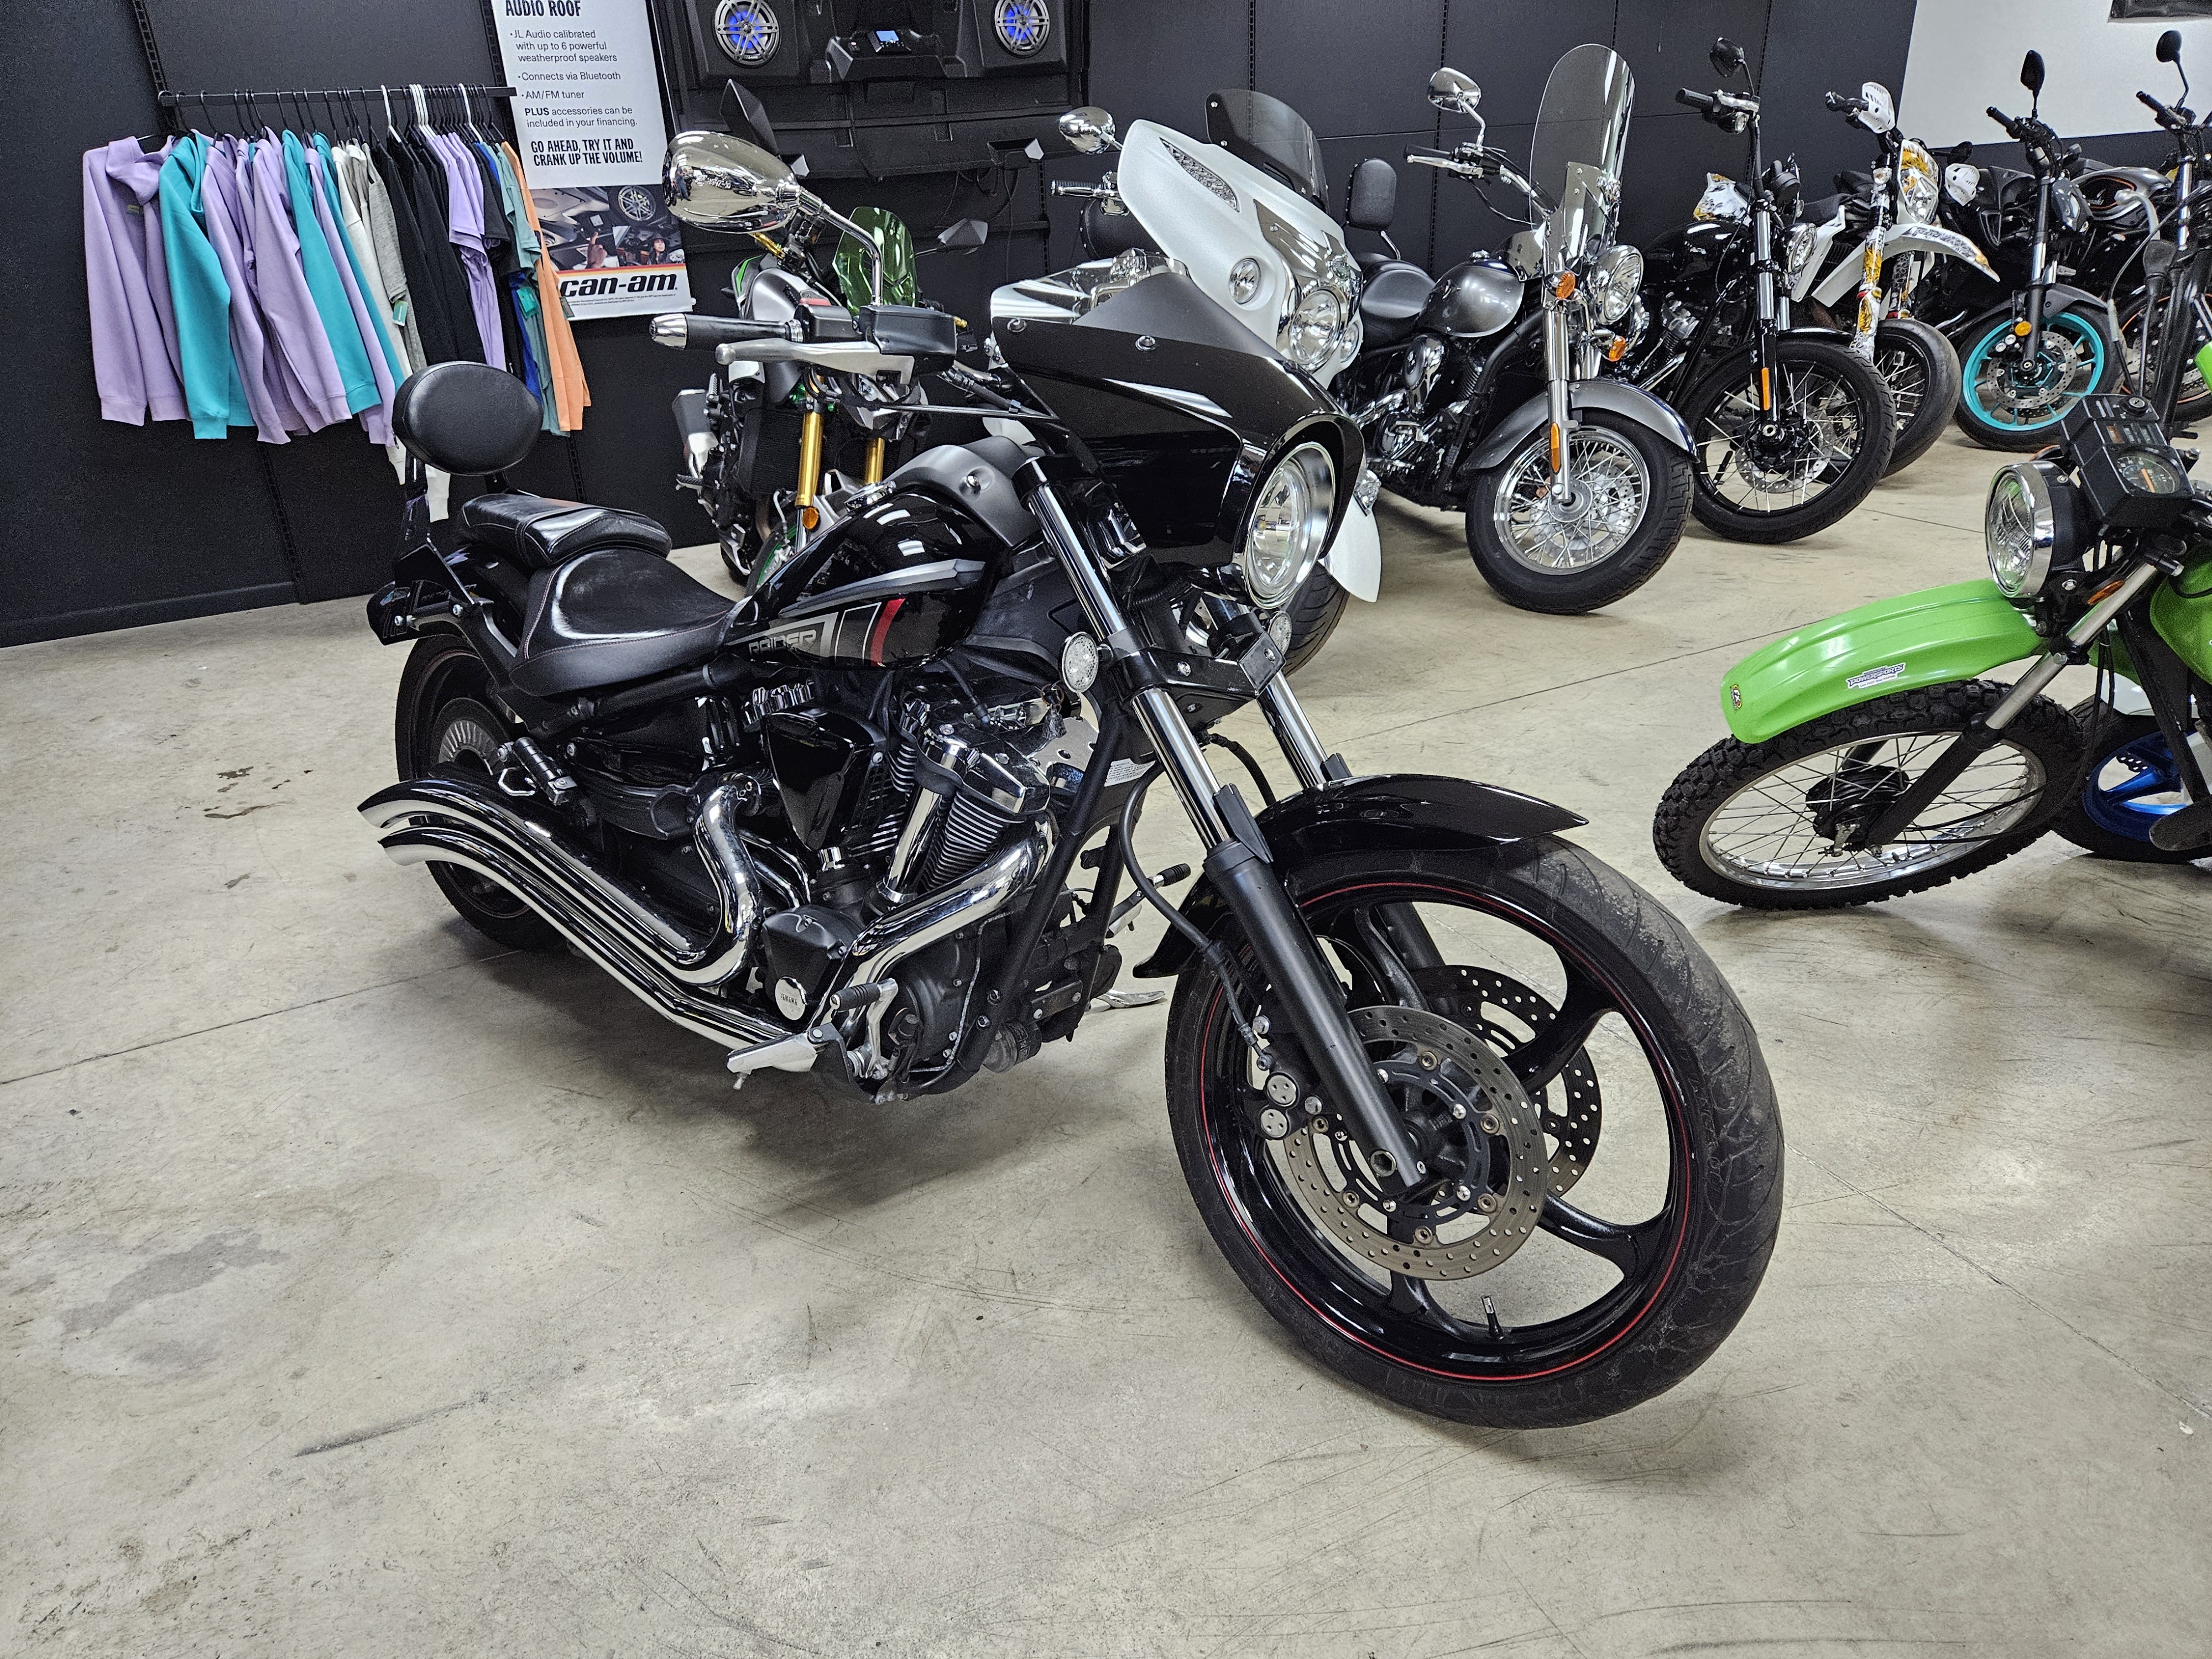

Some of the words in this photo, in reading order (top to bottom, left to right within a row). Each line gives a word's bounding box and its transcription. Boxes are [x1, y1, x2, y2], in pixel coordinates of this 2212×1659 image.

[505, 0, 545, 17] AUDIO
[549, 0, 581, 17] ROOF
[514, 30, 524, 38] JL
[526, 30, 551, 38] Audio
[553, 30, 596, 38] calibrated
[538, 43, 549, 51] up
[570, 41, 607, 51] powerful
[518, 54, 577, 64] weatherproof
[580, 54, 618, 63] speakers
[522, 72, 564, 81] Connects
[580, 71, 621, 80] Bluetooth
[525, 90, 560, 100] AM/FM
[525, 107, 550, 116] PLUS
[552, 107, 603, 116] accessories
[527, 118, 565, 128] included
[576, 119, 594, 128] your
[597, 118, 638, 127] financing.
[531, 140, 544, 153] GO
[547, 140, 581, 153] AHEAD,
[582, 139, 600, 151] TRY
[603, 139, 613, 150] IT
[614, 138, 634, 150] AND
[534, 153, 567, 166] CRANK
[568, 153, 581, 165] UP
[583, 152, 602, 164] THE
[603, 151, 643, 164] VOLUME!
[560, 273, 677, 297] can-am
[748, 629, 817, 655] RAIDER
[1848, 664, 1903, 686] POWERSPORTS
